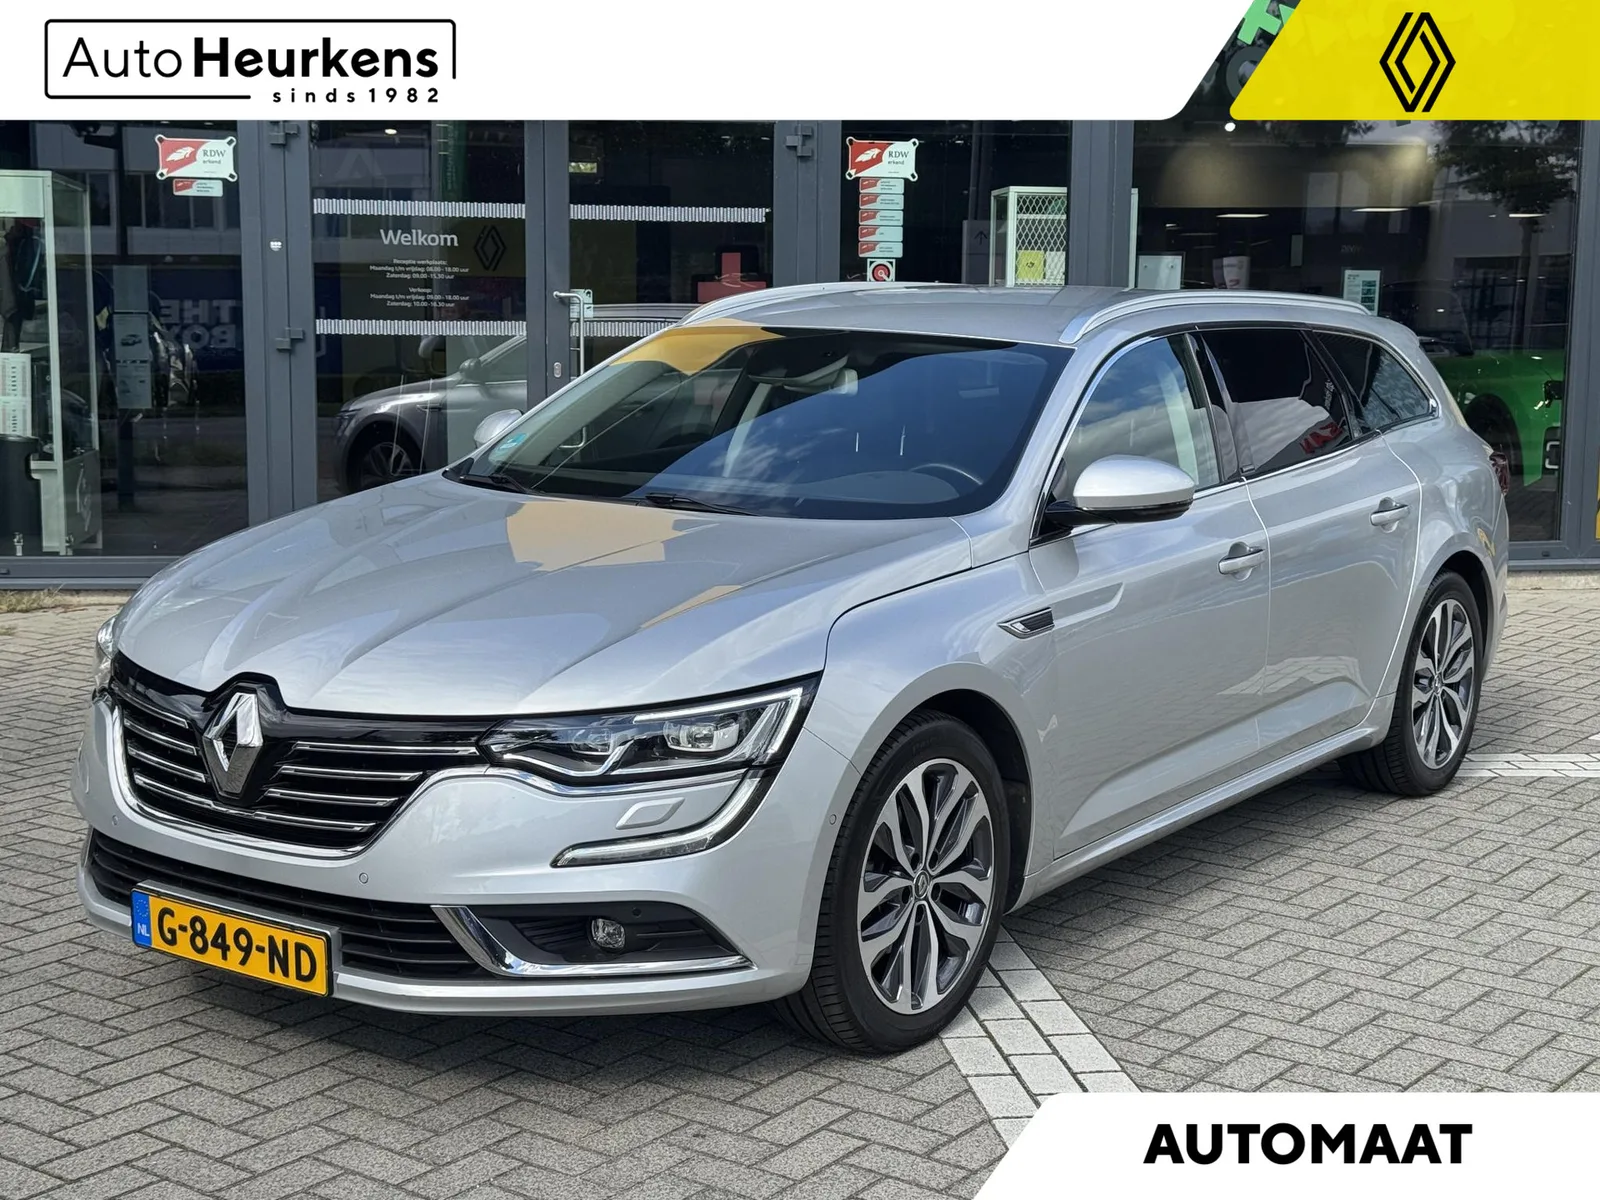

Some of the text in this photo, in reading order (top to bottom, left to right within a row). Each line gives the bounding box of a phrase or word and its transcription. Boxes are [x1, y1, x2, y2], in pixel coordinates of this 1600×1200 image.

[202, 149, 226, 158] RDW
[888, 150, 910, 159] RDW
[380, 229, 459, 247] Welkom
[386, 300, 412, 308] Zaterdag:
[137, 922, 150, 937] NL
[157, 906, 317, 983] G-849-ND
